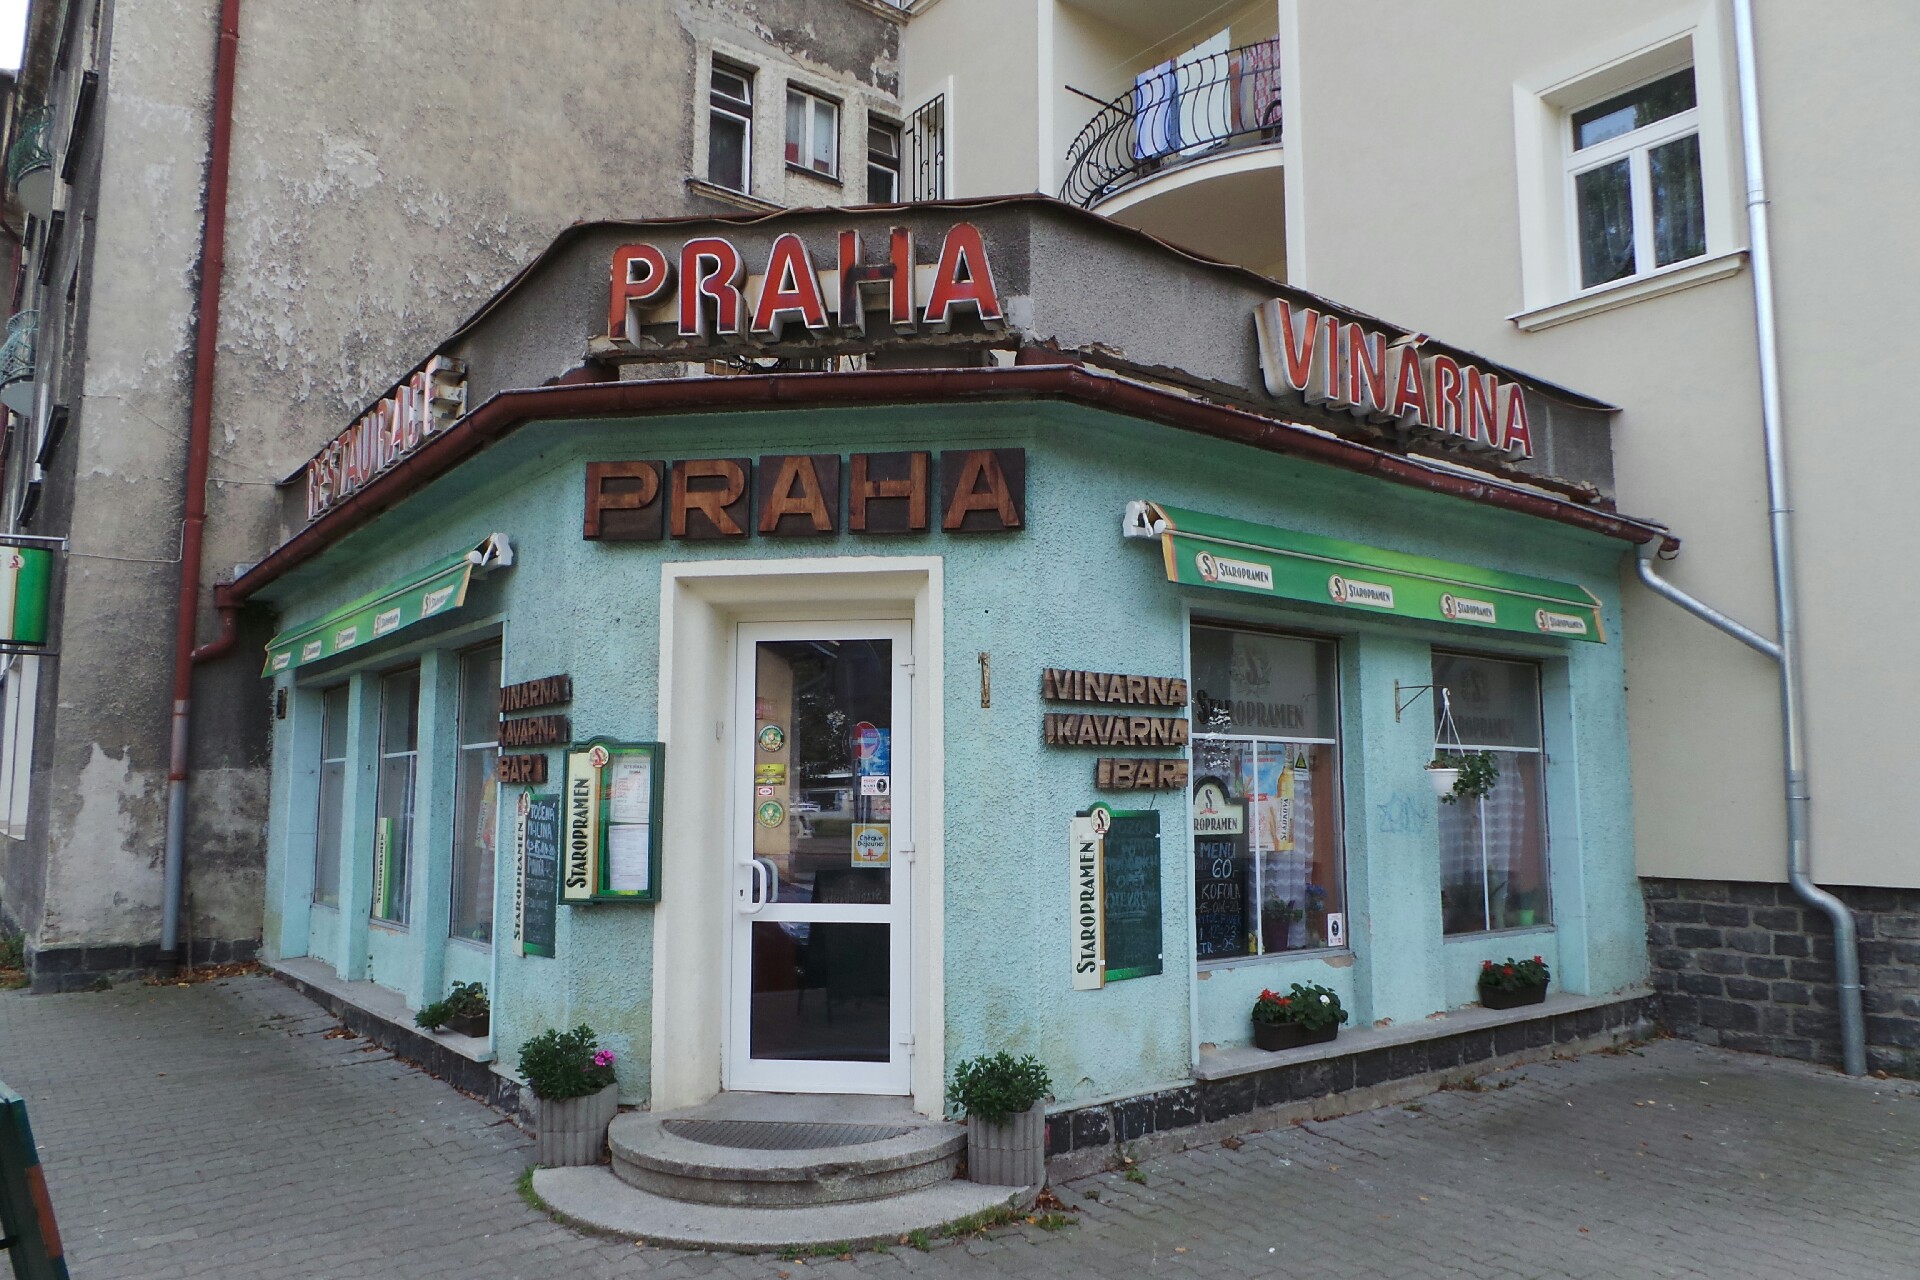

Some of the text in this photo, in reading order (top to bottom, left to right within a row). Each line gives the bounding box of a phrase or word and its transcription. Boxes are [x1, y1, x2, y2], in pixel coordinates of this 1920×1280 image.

[606, 221, 1004, 344] PRAHA
[583, 449, 1022, 538] PRAHA
[1219, 562, 1270, 584] STAROPRAMEN
[1349, 584, 1391, 602] STAROPRAMEN
[498, 755, 532, 783] BAR
[1113, 758, 1177, 789] BAR
[566, 777, 591, 889] STAROPRAMEN
[1194, 817, 1238, 832] ROPRAMEN
[514, 821, 524, 941] STAROPRAMEN
[1075, 841, 1096, 974] STAROPRAMEN
